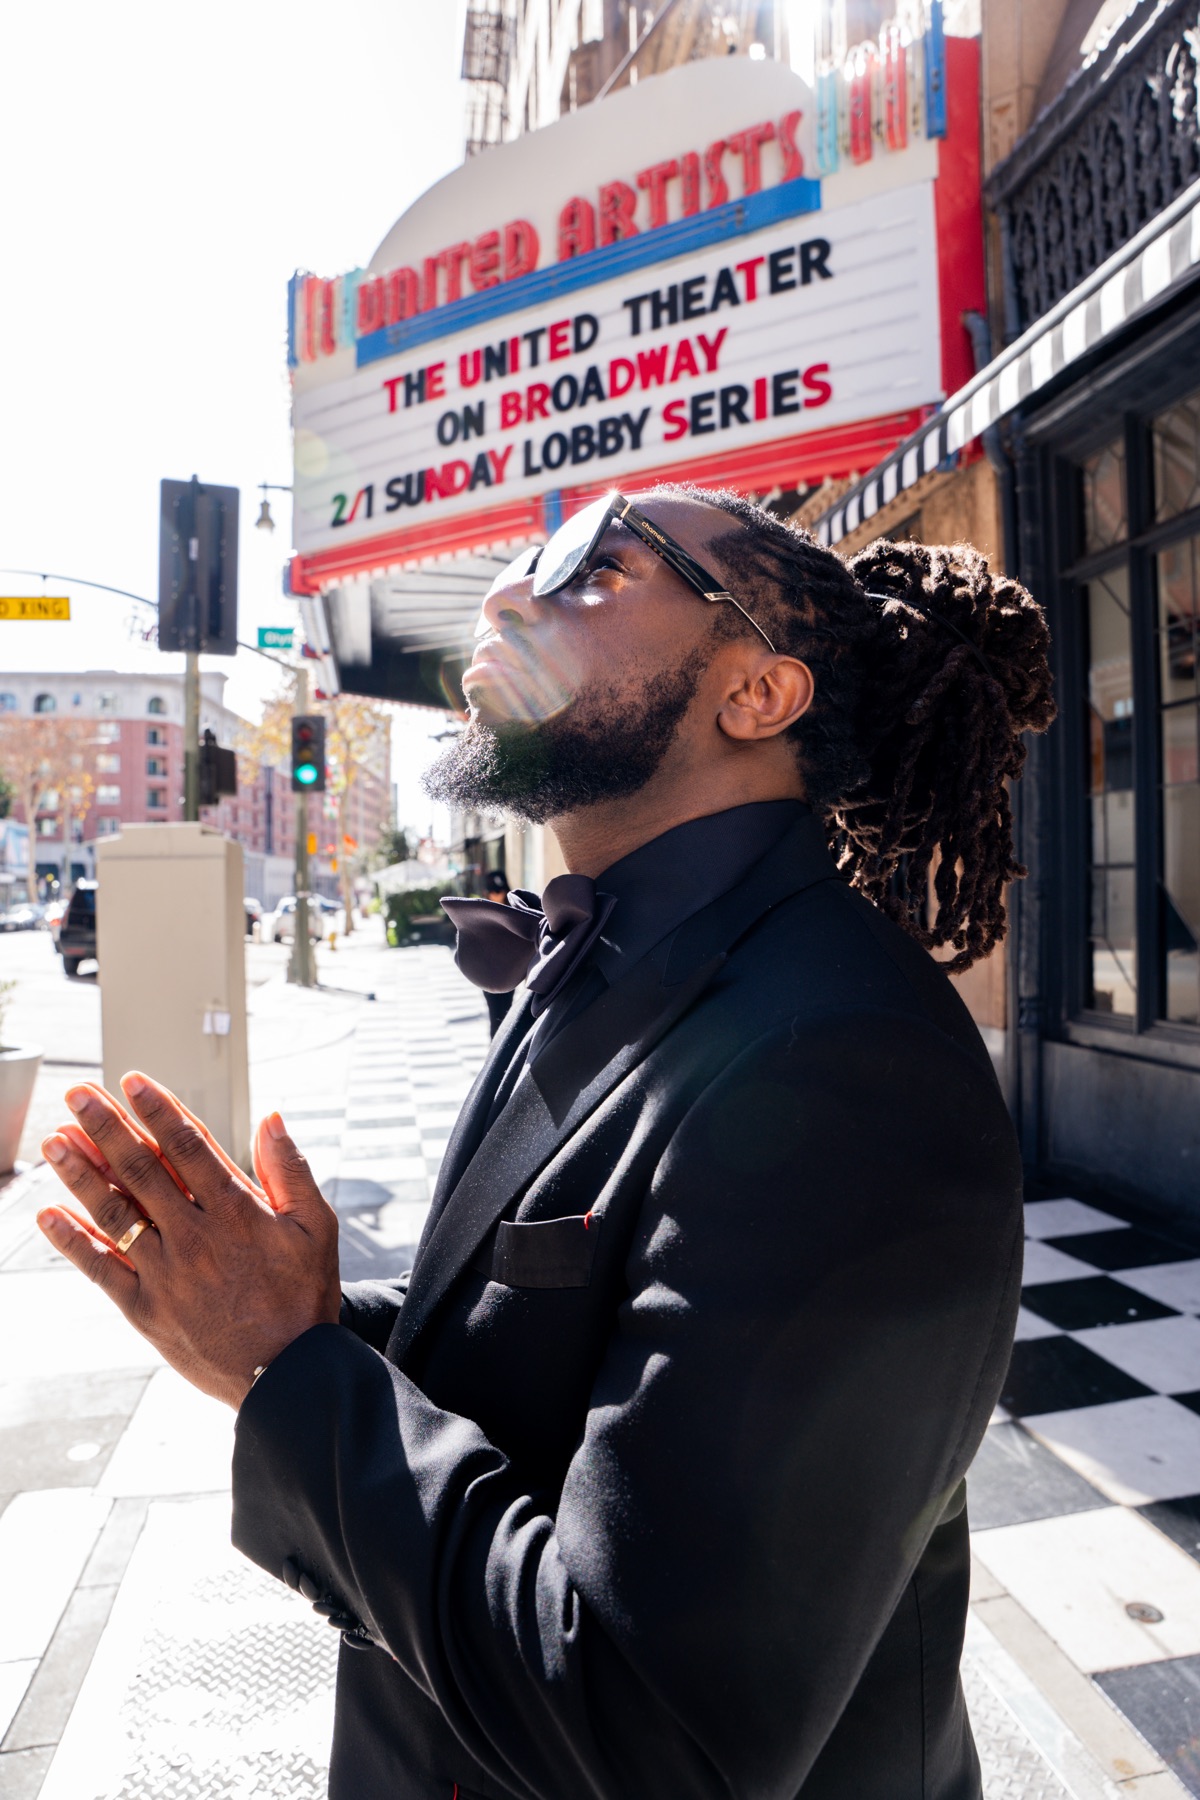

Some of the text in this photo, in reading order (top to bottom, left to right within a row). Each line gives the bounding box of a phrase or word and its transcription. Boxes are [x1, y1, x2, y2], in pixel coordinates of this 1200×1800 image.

[357, 109, 804, 336] UNITED ARTISTS
[383, 237, 833, 413] THE UNITED THEATER
[436, 327, 728, 446] ON BROADWAY
[330, 362, 834, 528] 2/1 SUNDAY LOBBY SERIES
[642, 521, 667, 544] chamelo
